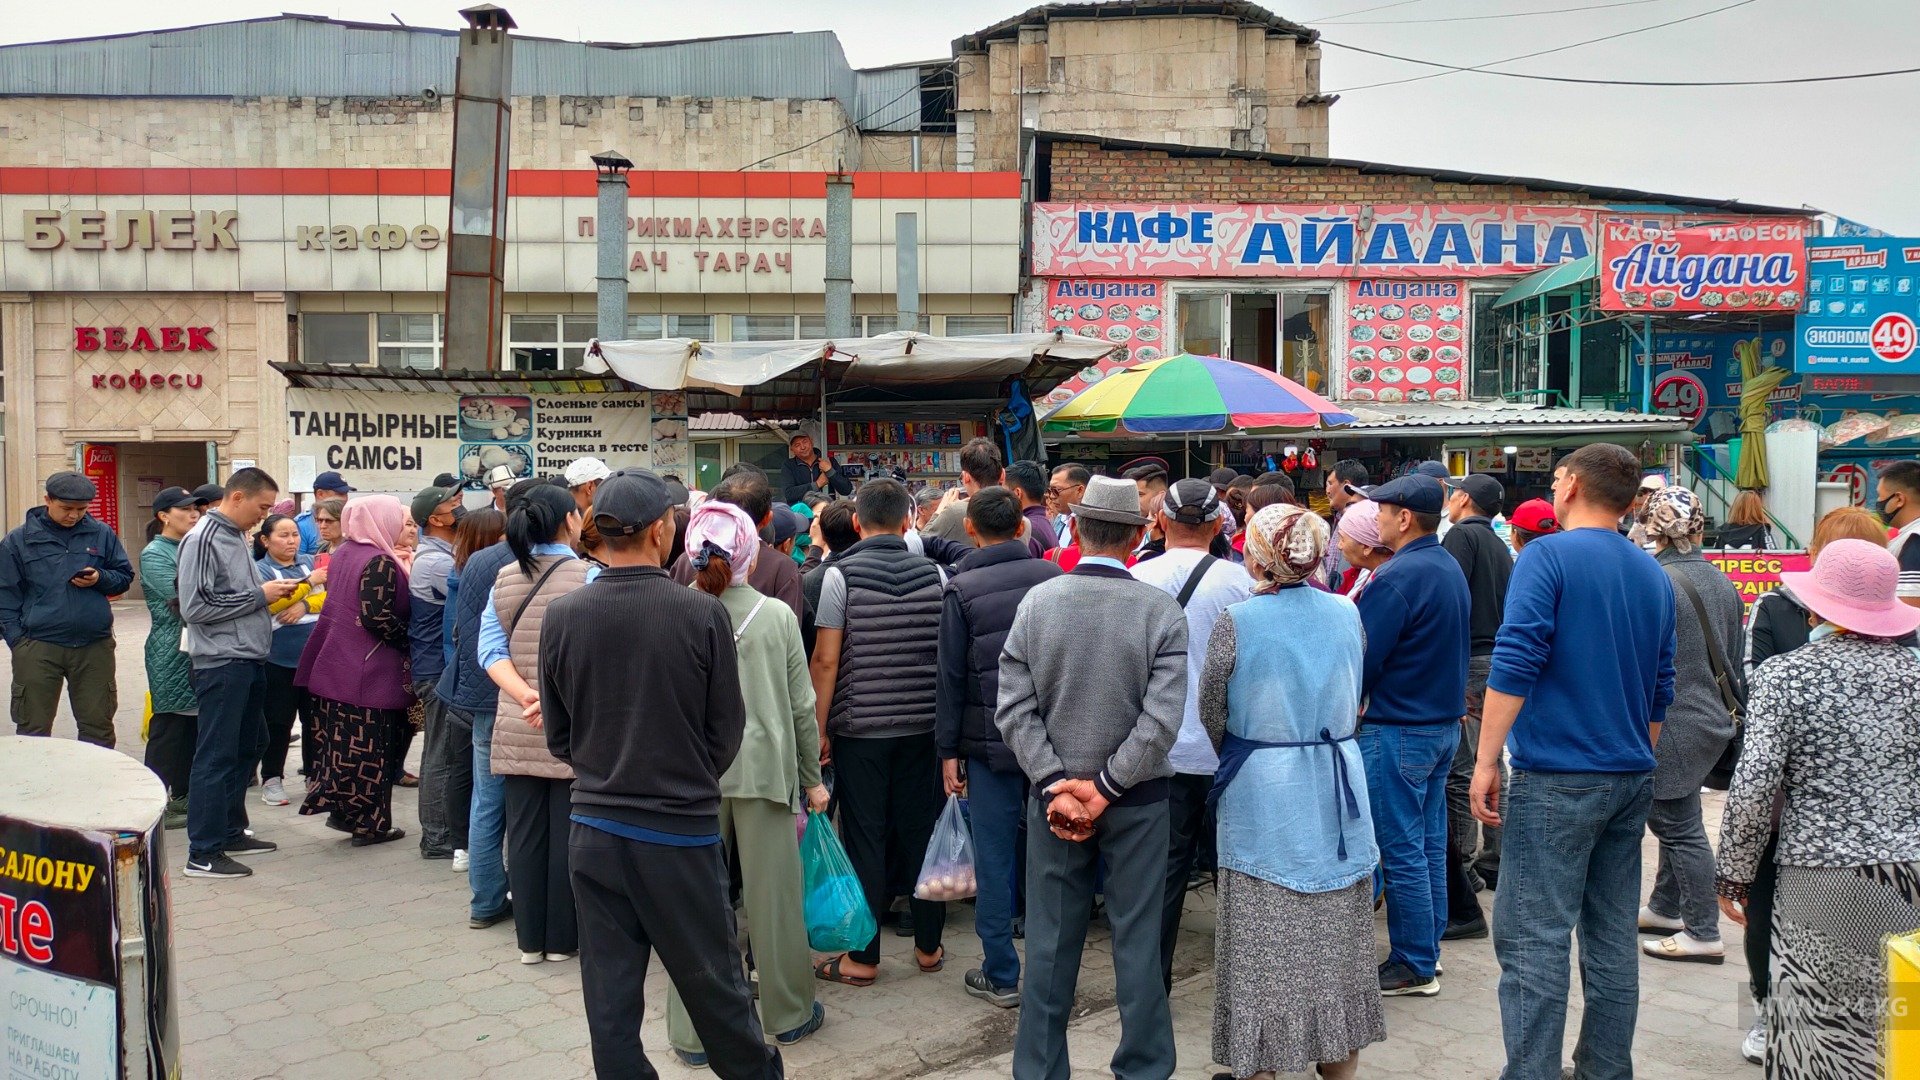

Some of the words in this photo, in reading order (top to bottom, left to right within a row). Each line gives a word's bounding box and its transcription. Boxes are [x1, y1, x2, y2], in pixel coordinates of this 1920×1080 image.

[23, 210, 240, 250] БЕЛЕК
[297, 223, 449, 250] кафе
[578, 217, 826, 238] ПРИКМАХЕРСКА
[1078, 211, 1214, 244] КАФЕ
[1240, 215, 1592, 266] АЙДАНА
[1609, 226, 1677, 241] КАФЕ
[1708, 225, 1801, 241] КАФЕСИ
[630, 251, 667, 271] АЧ
[694, 251, 792, 273] ТАРАЧ
[1610, 242, 1798, 298] Айдана
[1056, 280, 1157, 300] Айдана
[1357, 280, 1458, 300] Айдана
[75, 327, 217, 351] БЕЛЕК
[1808, 330, 1868, 344] ЭКОНОМ
[1874, 321, 1912, 353] 49
[537, 398, 597, 409] Слоеные
[602, 399, 645, 408] самсы
[1659, 383, 1700, 413] 49
[1767, 385, 1799, 400] ААЛАР!
[290, 411, 457, 442] ТАНДЫРНЫЕ
[537, 413, 592, 424] Беляши
[537, 428, 602, 440] Курники
[327, 445, 422, 470] САМСЫ
[537, 443, 595, 453] Сосиска
[611, 443, 649, 452] тесте
[10, 990, 78, 1030] СРОЧНО!
[8, 1026, 80, 1066] ПРИГЛАШАЕМ
[8, 1046, 22, 1067] НА
[26, 1055, 80, 1080] РАБОТУ
